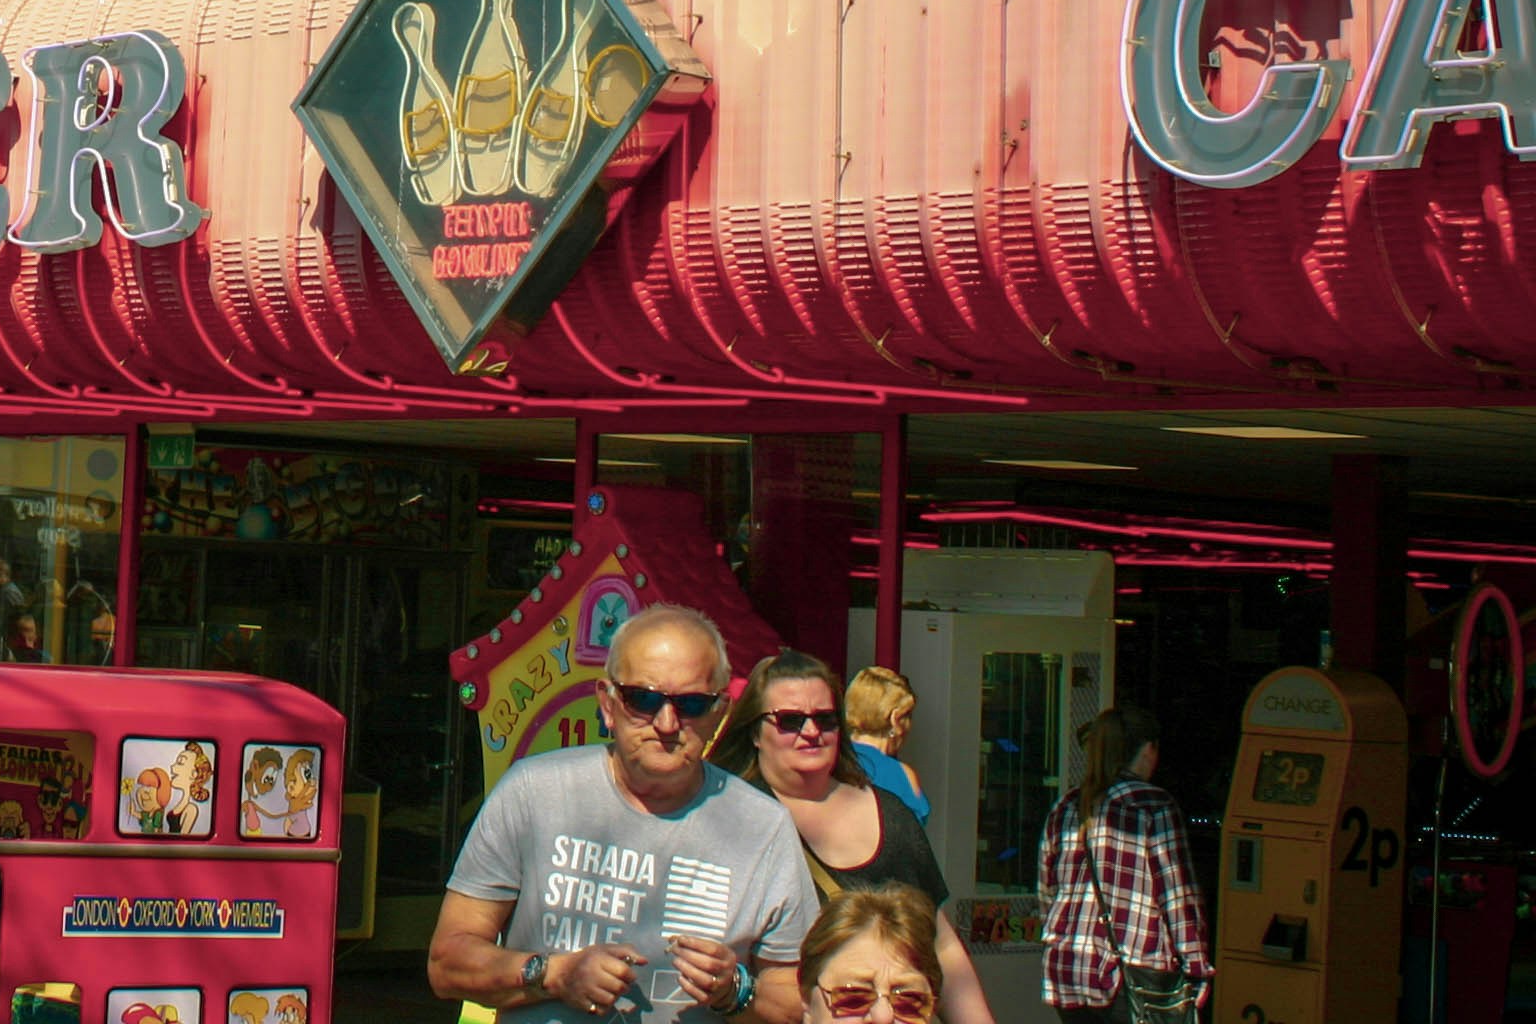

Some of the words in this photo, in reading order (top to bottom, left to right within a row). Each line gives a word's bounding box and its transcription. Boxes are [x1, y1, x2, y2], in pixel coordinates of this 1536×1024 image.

[442, 202, 532, 238] TENPIN
[484, 638, 571, 752] CRAZY
[1263, 695, 1333, 715] CHANGE
[1276, 758, 1313, 791] 2p
[551, 835, 656, 886] STRADA
[1340, 806, 1400, 888] 2p
[72, 899, 117, 927] LONDON
[132, 899, 176, 927] OXFORD
[189, 900, 217, 927] YORK
[232, 901, 277, 928] WEMBLEY
[544, 872, 647, 924] STREET
